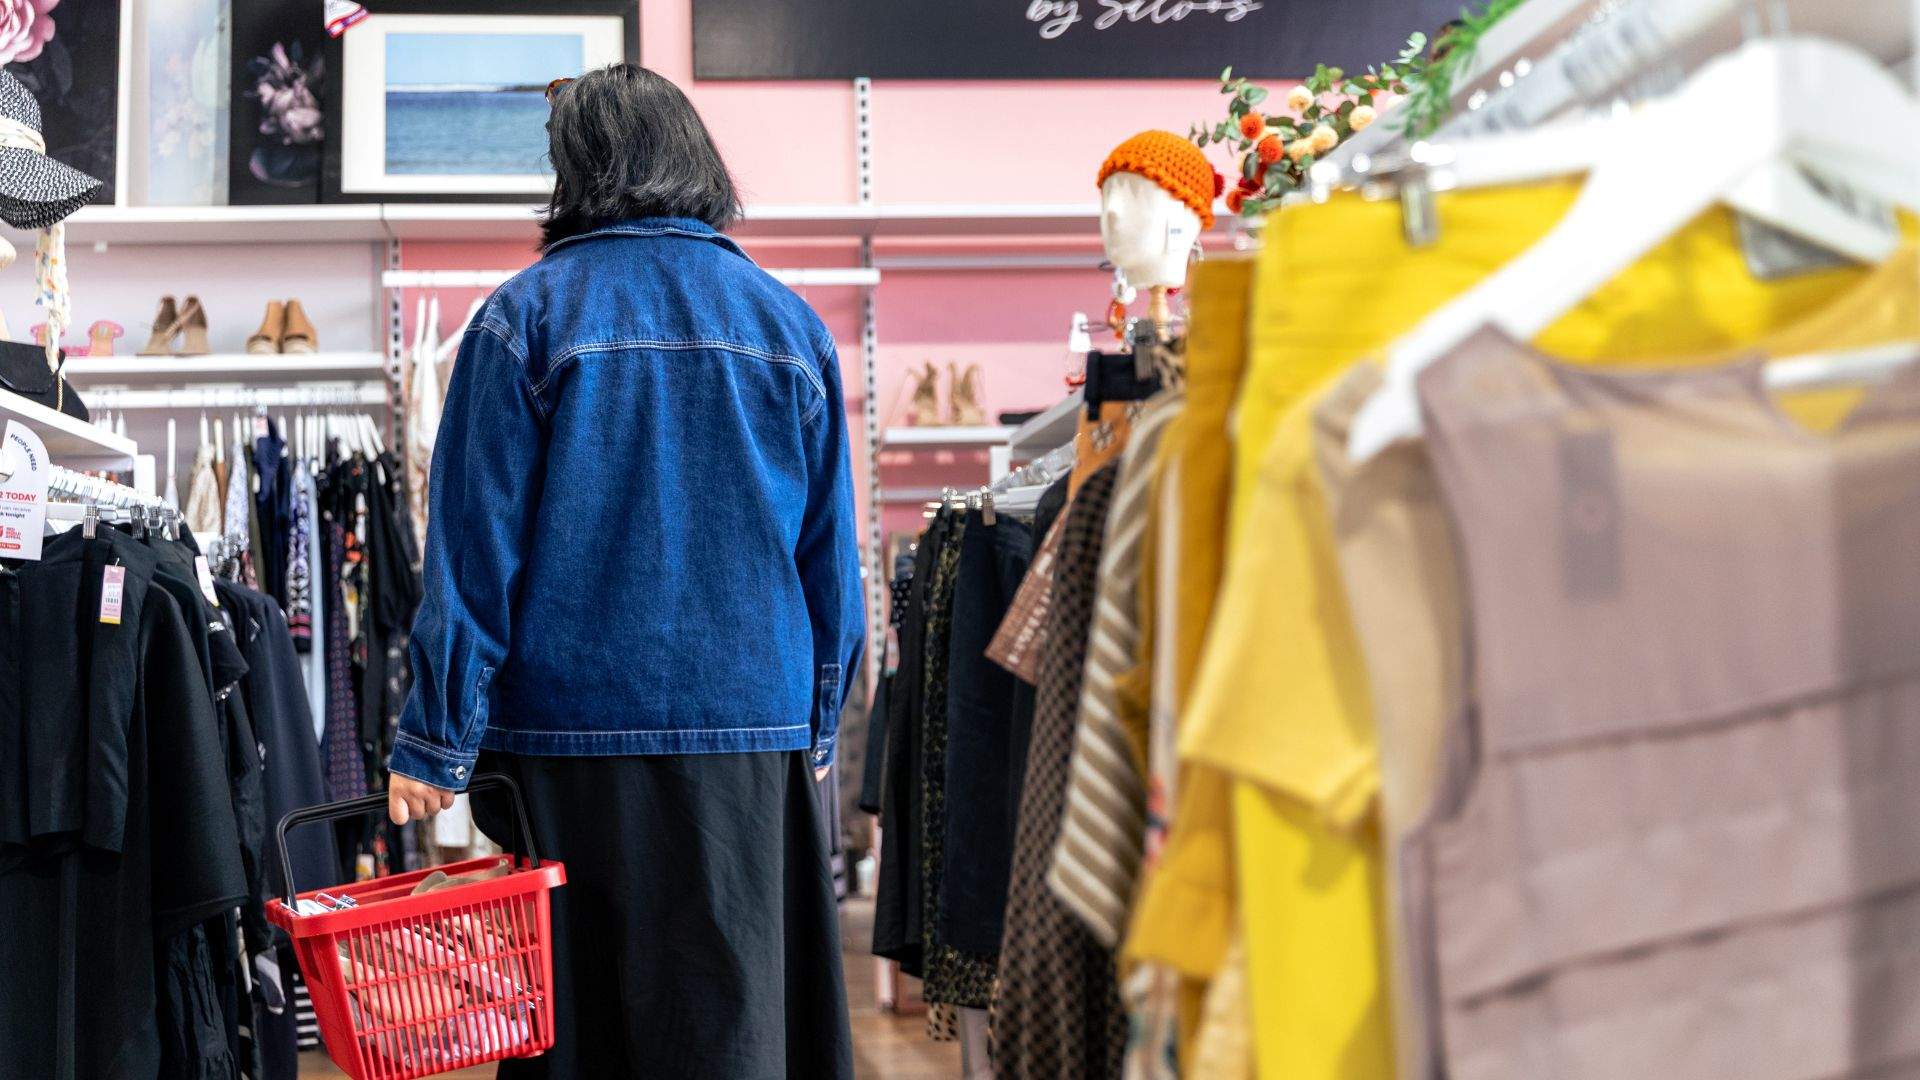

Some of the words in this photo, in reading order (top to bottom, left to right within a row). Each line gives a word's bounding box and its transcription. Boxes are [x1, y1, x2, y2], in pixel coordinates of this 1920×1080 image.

[1026, 0, 1082, 39] by
[10, 433, 31, 453] PEOPLE
[29, 453, 37, 471] NEED
[6, 492, 37, 502] TODAY
